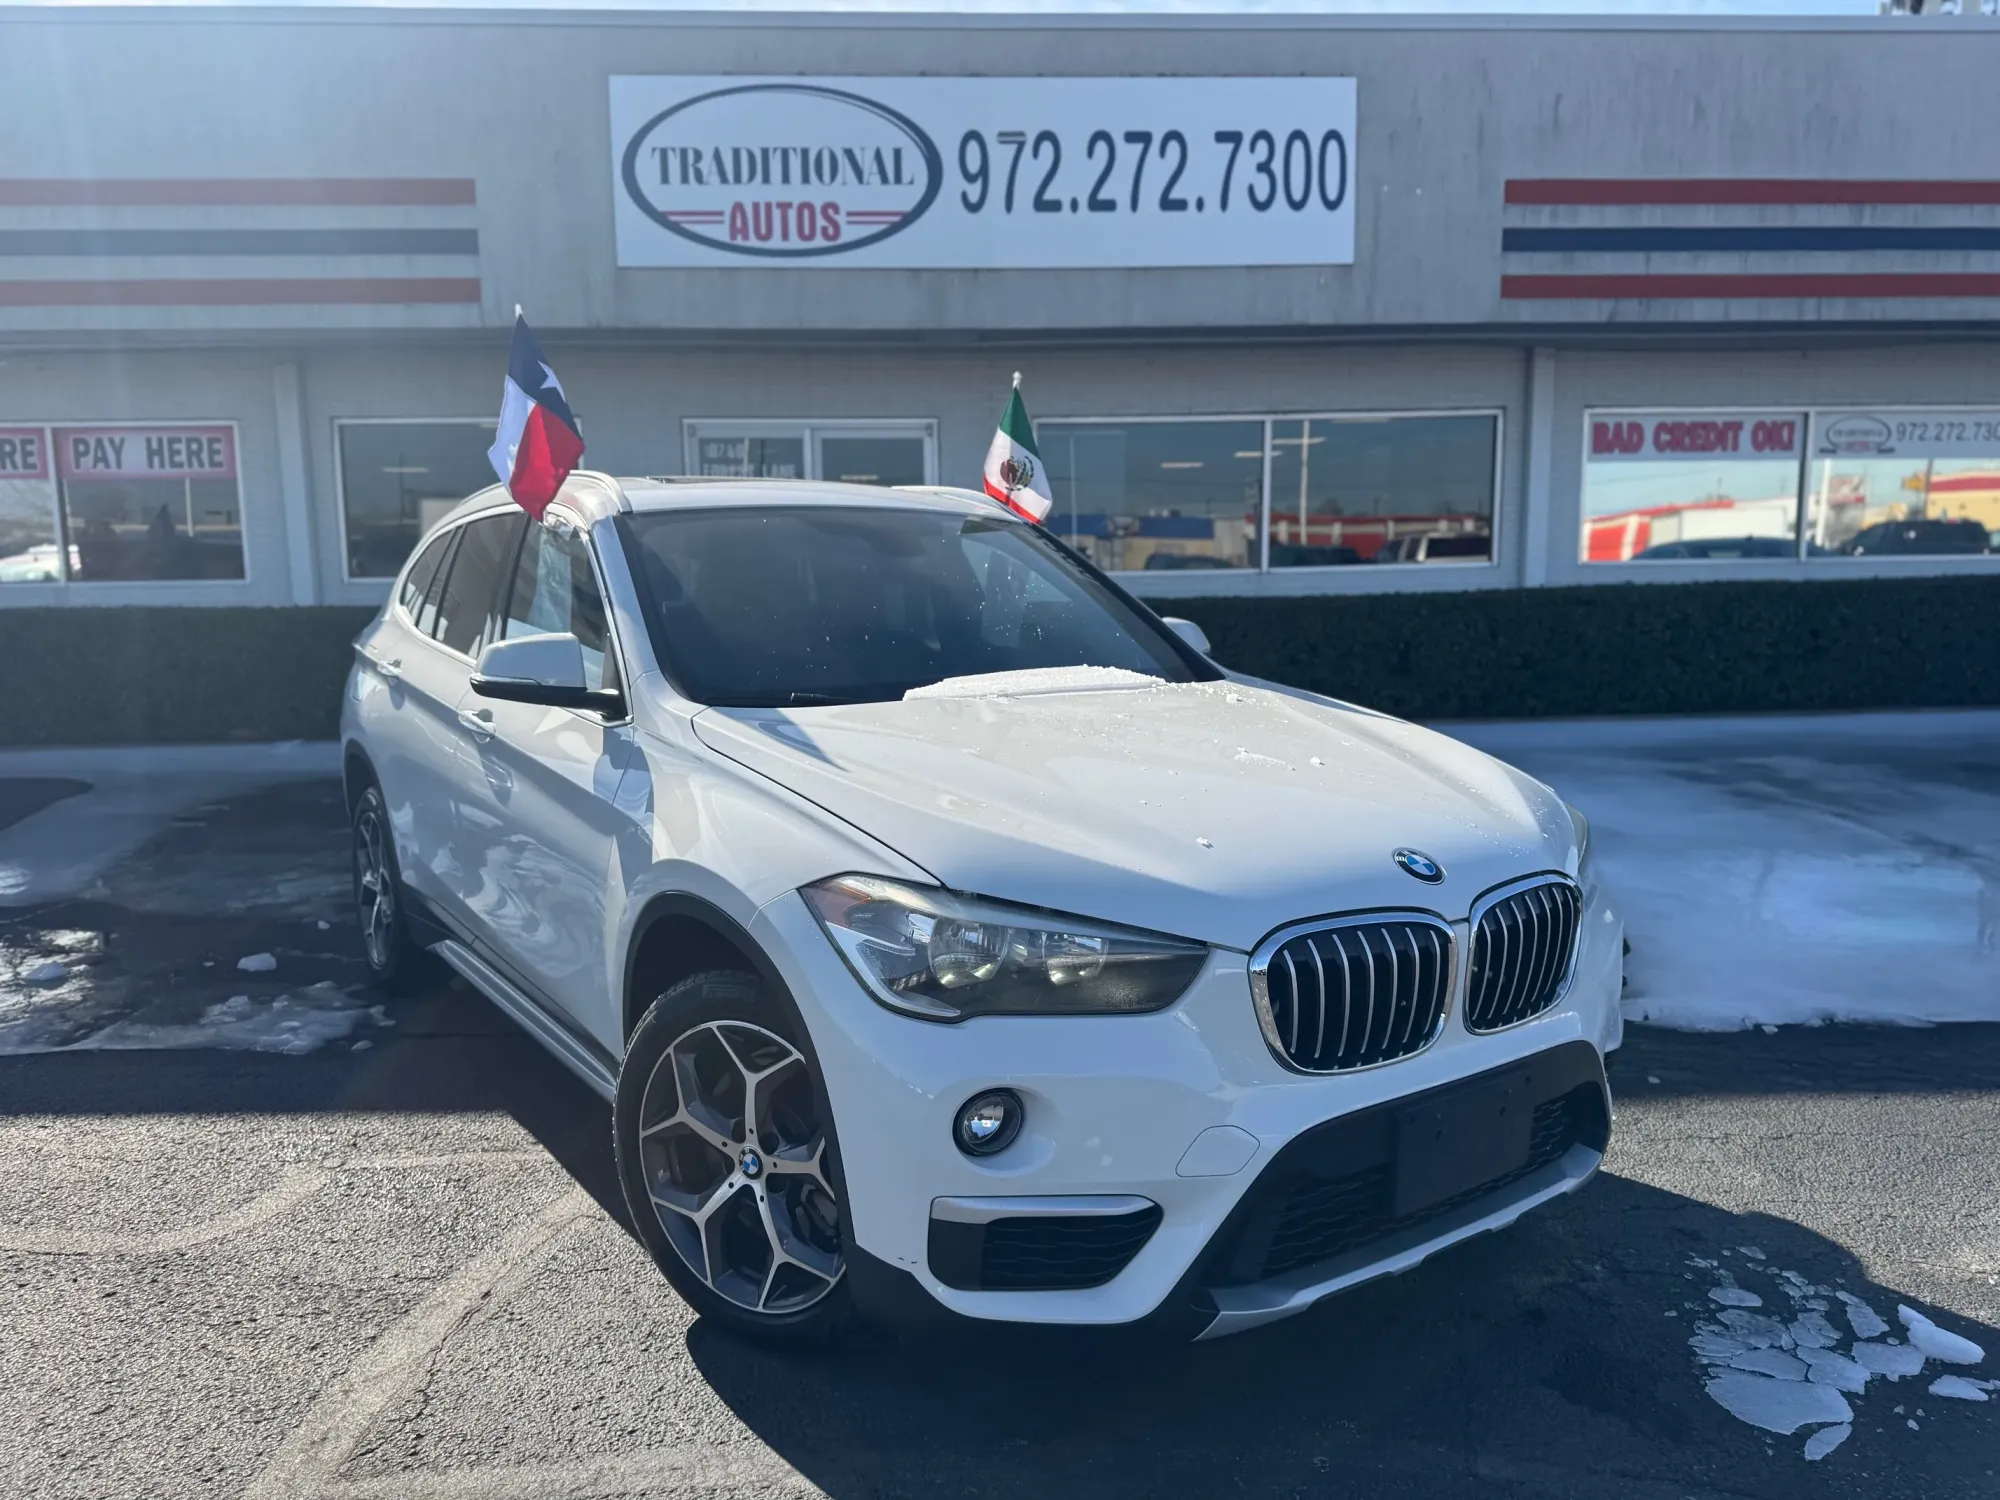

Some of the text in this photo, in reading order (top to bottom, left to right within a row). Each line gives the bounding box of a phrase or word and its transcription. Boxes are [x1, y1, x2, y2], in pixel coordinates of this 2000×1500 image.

[651, 145, 914, 187] TRADITIONAL
[957, 128, 1348, 215] 972.272.7300
[729, 201, 842, 242] AUTOS
[71, 436, 225, 470] PAY HERE
[1592, 421, 1646, 455] BAD
[1653, 420, 1744, 454] CREDIT
